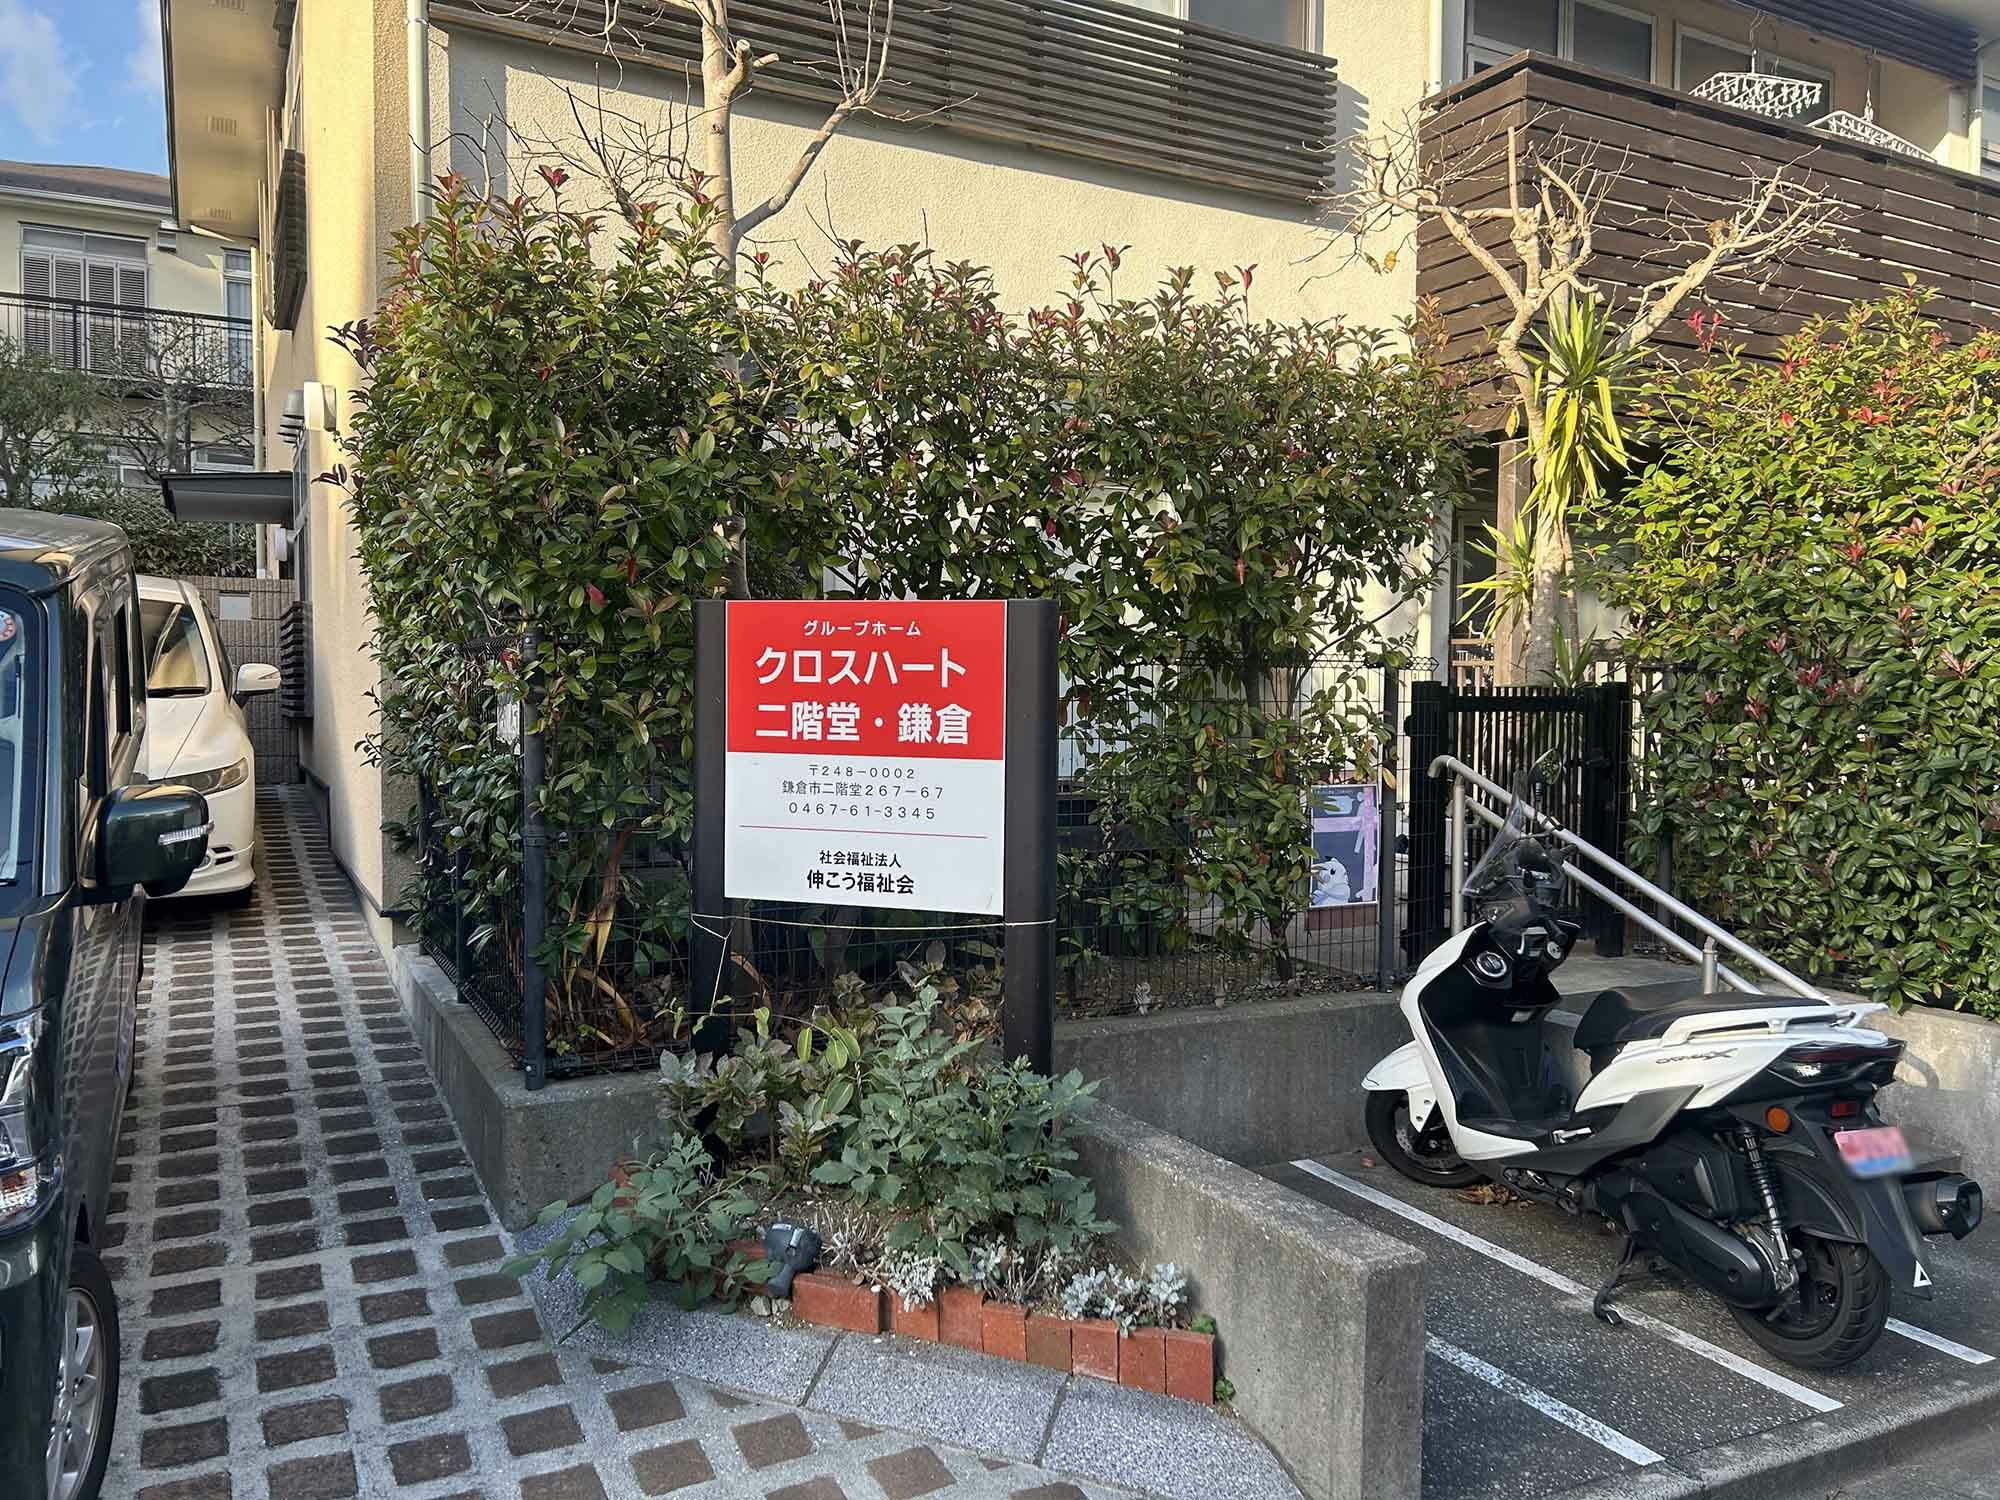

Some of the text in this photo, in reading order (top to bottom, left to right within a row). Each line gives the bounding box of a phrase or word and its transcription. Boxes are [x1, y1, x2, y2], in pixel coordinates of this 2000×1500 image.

[803, 620, 921, 637] グループホーム
[755, 647, 968, 688] クロスハート
[755, 702, 972, 745] 二階堂・鎌倉
[782, 780, 944, 800] 鎌倉市二階堂267-67
[788, 801, 936, 820] 0467-61-3345
[819, 850, 902, 869] 社会福祉法人
[806, 870, 915, 895] 伸こう福祉会
